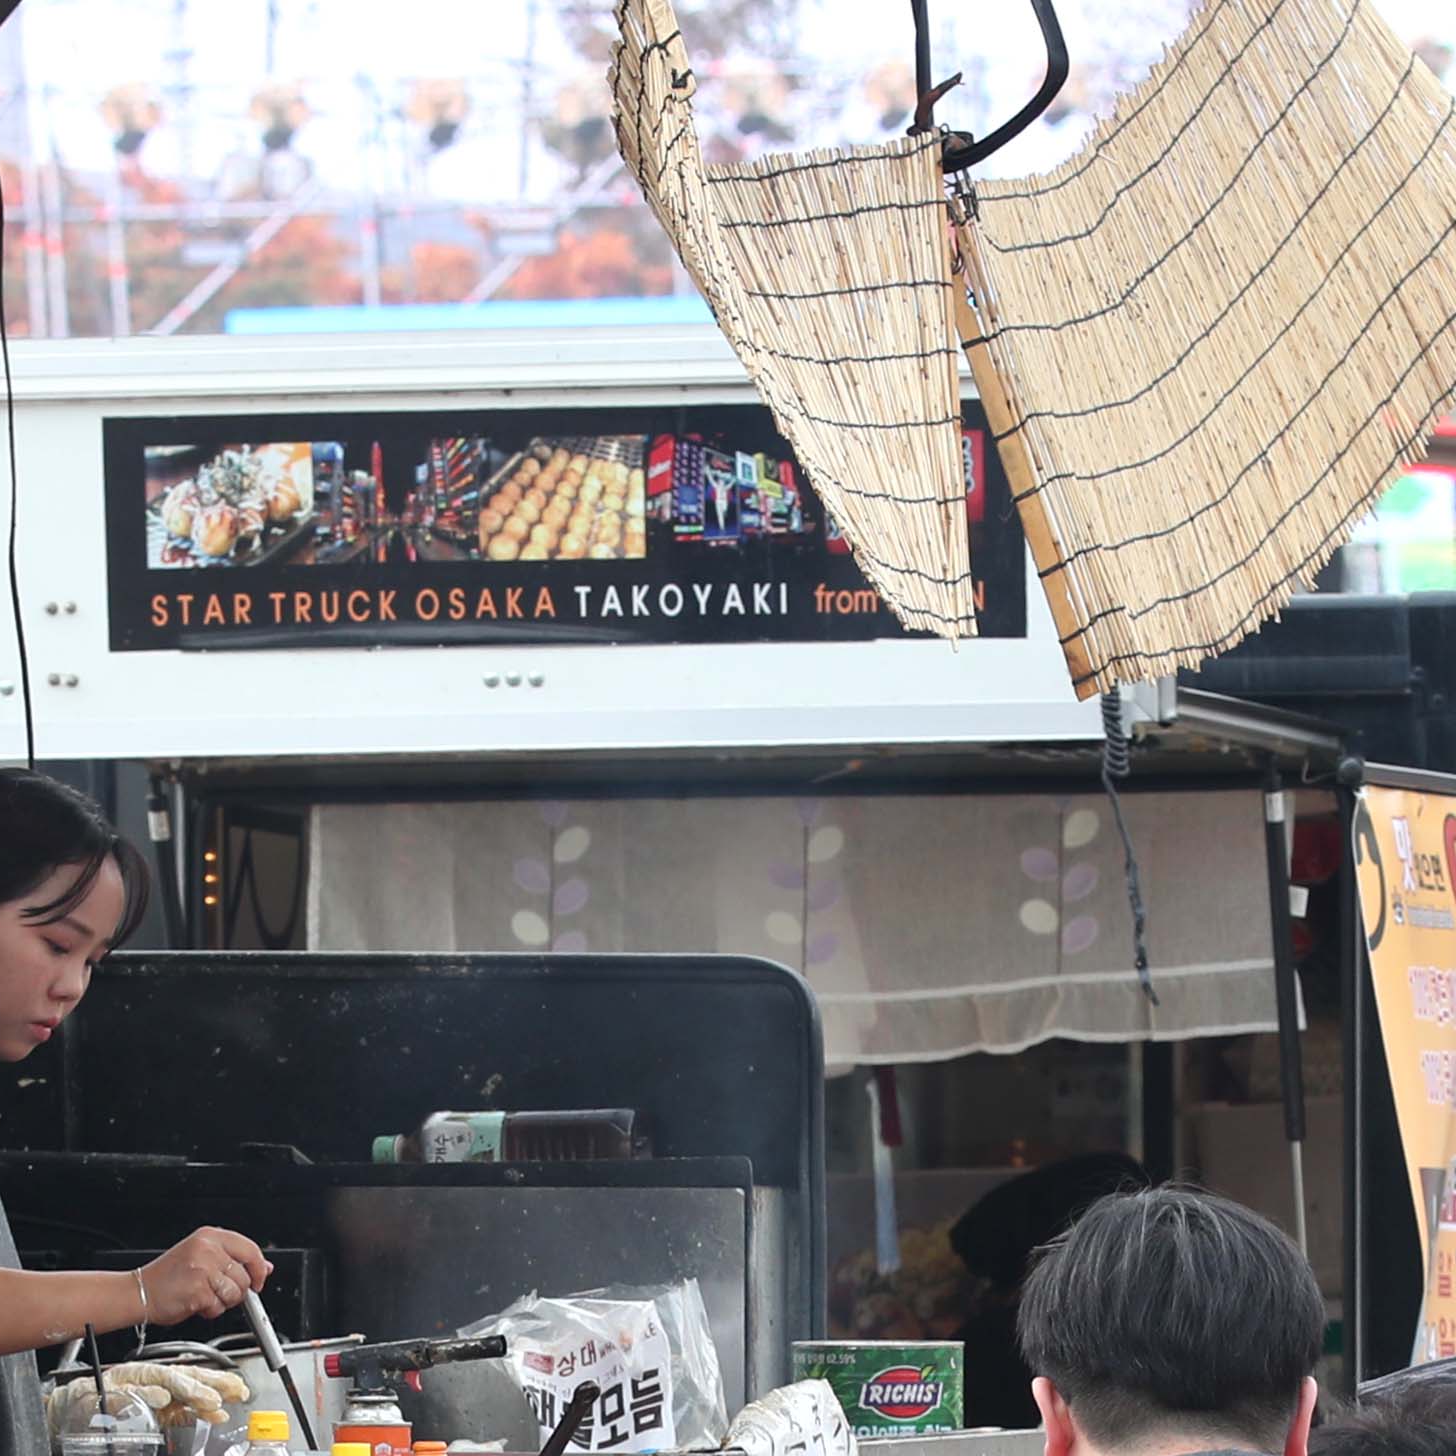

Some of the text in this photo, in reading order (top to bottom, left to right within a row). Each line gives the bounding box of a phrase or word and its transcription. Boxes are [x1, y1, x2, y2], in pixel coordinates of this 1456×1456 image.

[151, 593, 253, 628] STAR
[269, 588, 398, 624] TRUCK
[415, 586, 558, 621] OSAKA
[574, 582, 789, 618] TAKOYAKI
[522, 1367, 665, 1450] 해모듬
[869, 1384, 938, 1405] RICHIS
